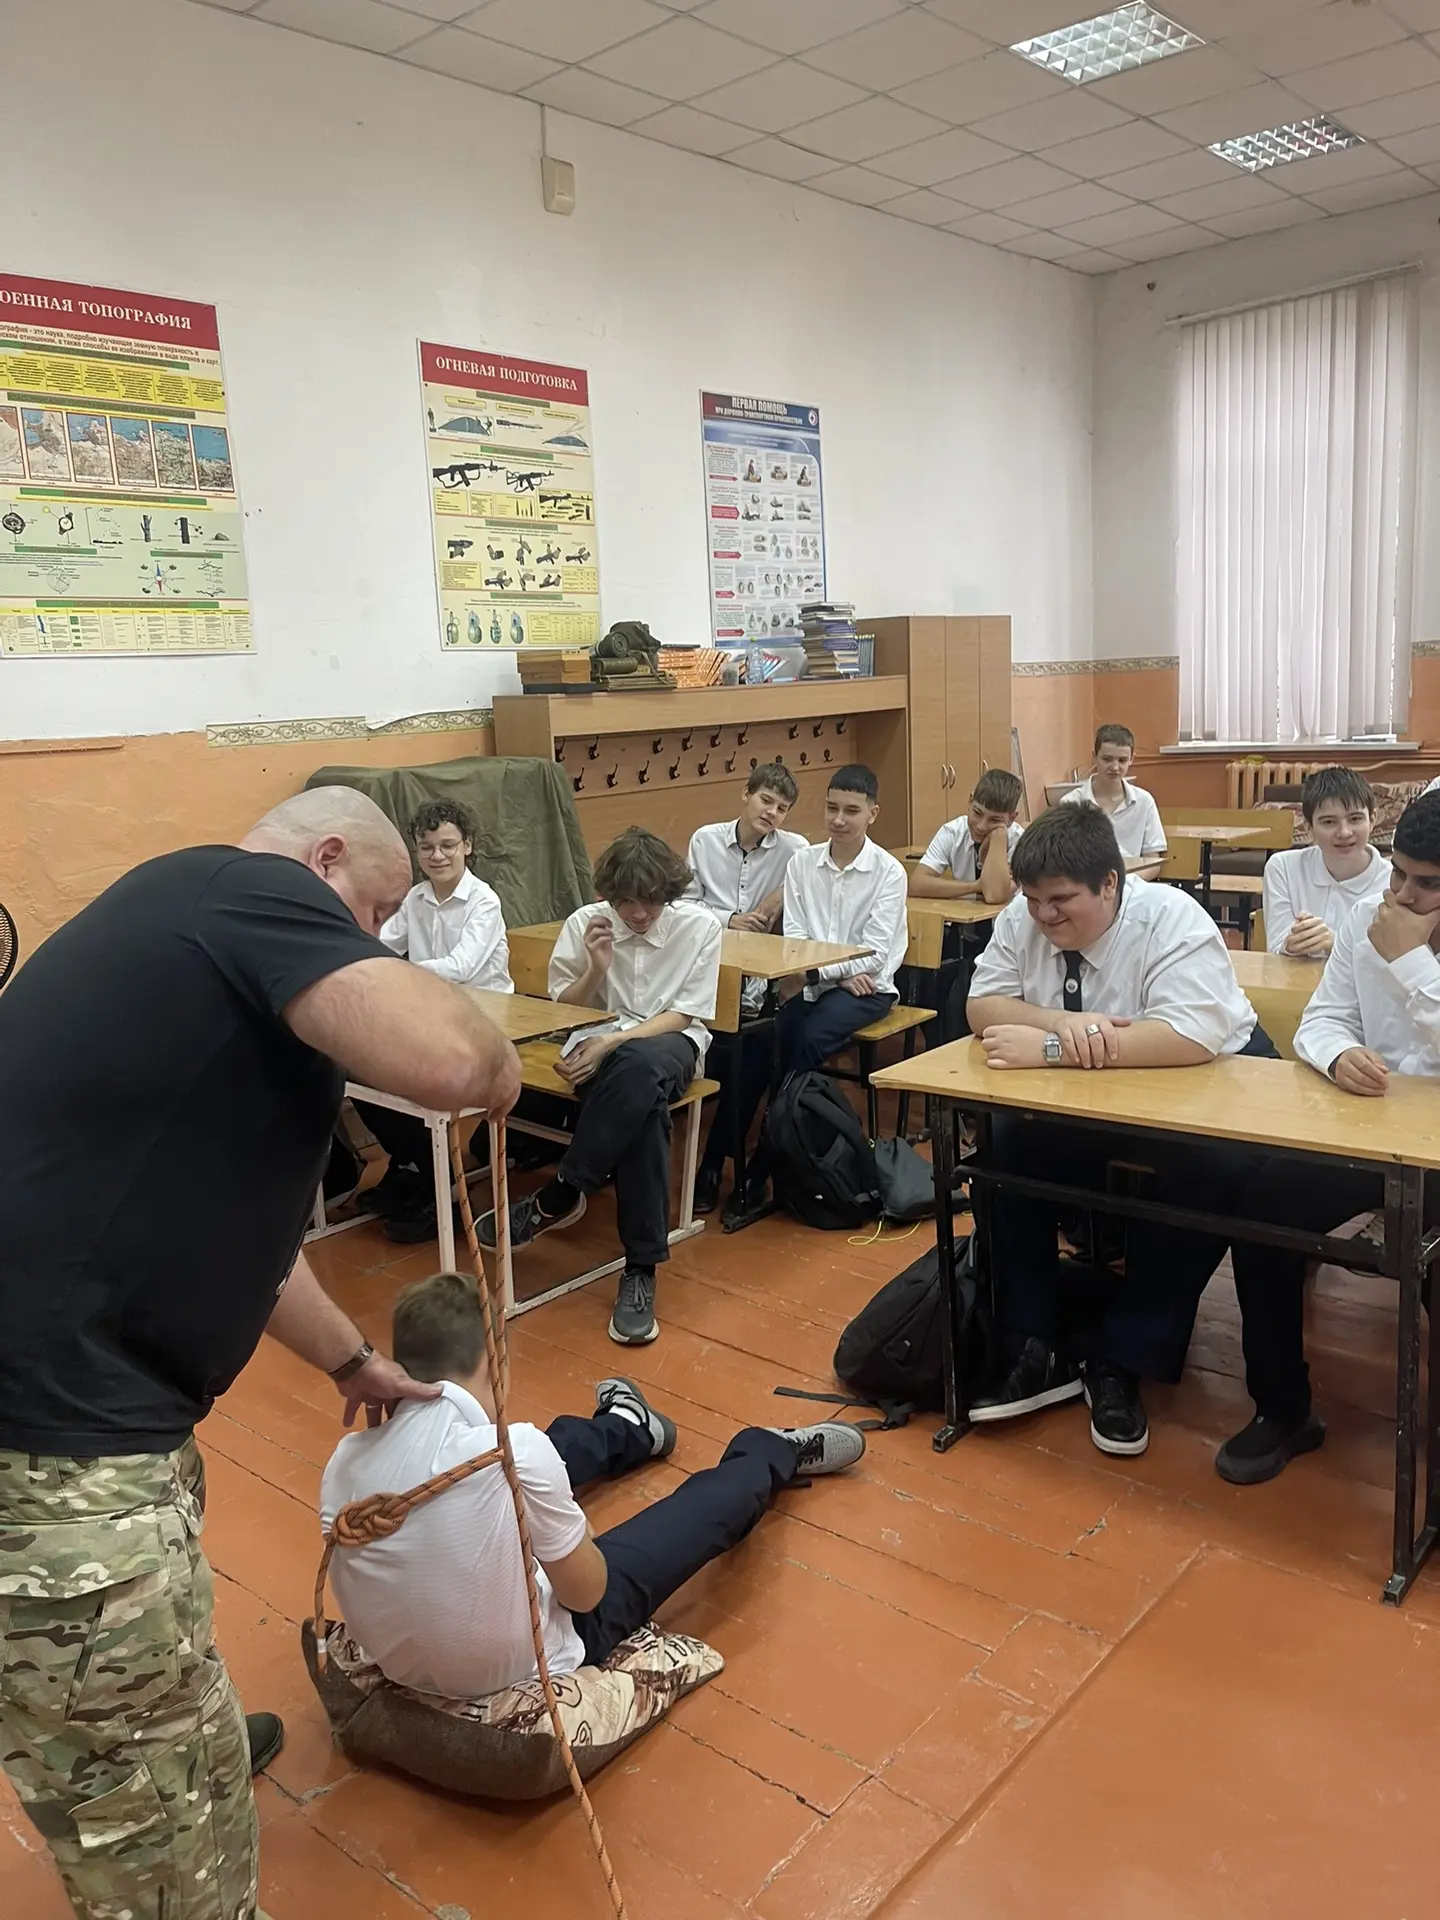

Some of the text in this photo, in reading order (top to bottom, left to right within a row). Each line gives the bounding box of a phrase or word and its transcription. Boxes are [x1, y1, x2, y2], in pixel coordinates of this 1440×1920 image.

[78, 301, 192, 330] ТОПОГРАФИЯ
[436, 356, 578, 391] ОГНЕВАЯ ПОДГОТОВКА
[731, 396, 788, 416] ПЕРВАЯ ПОМОЩЬ
